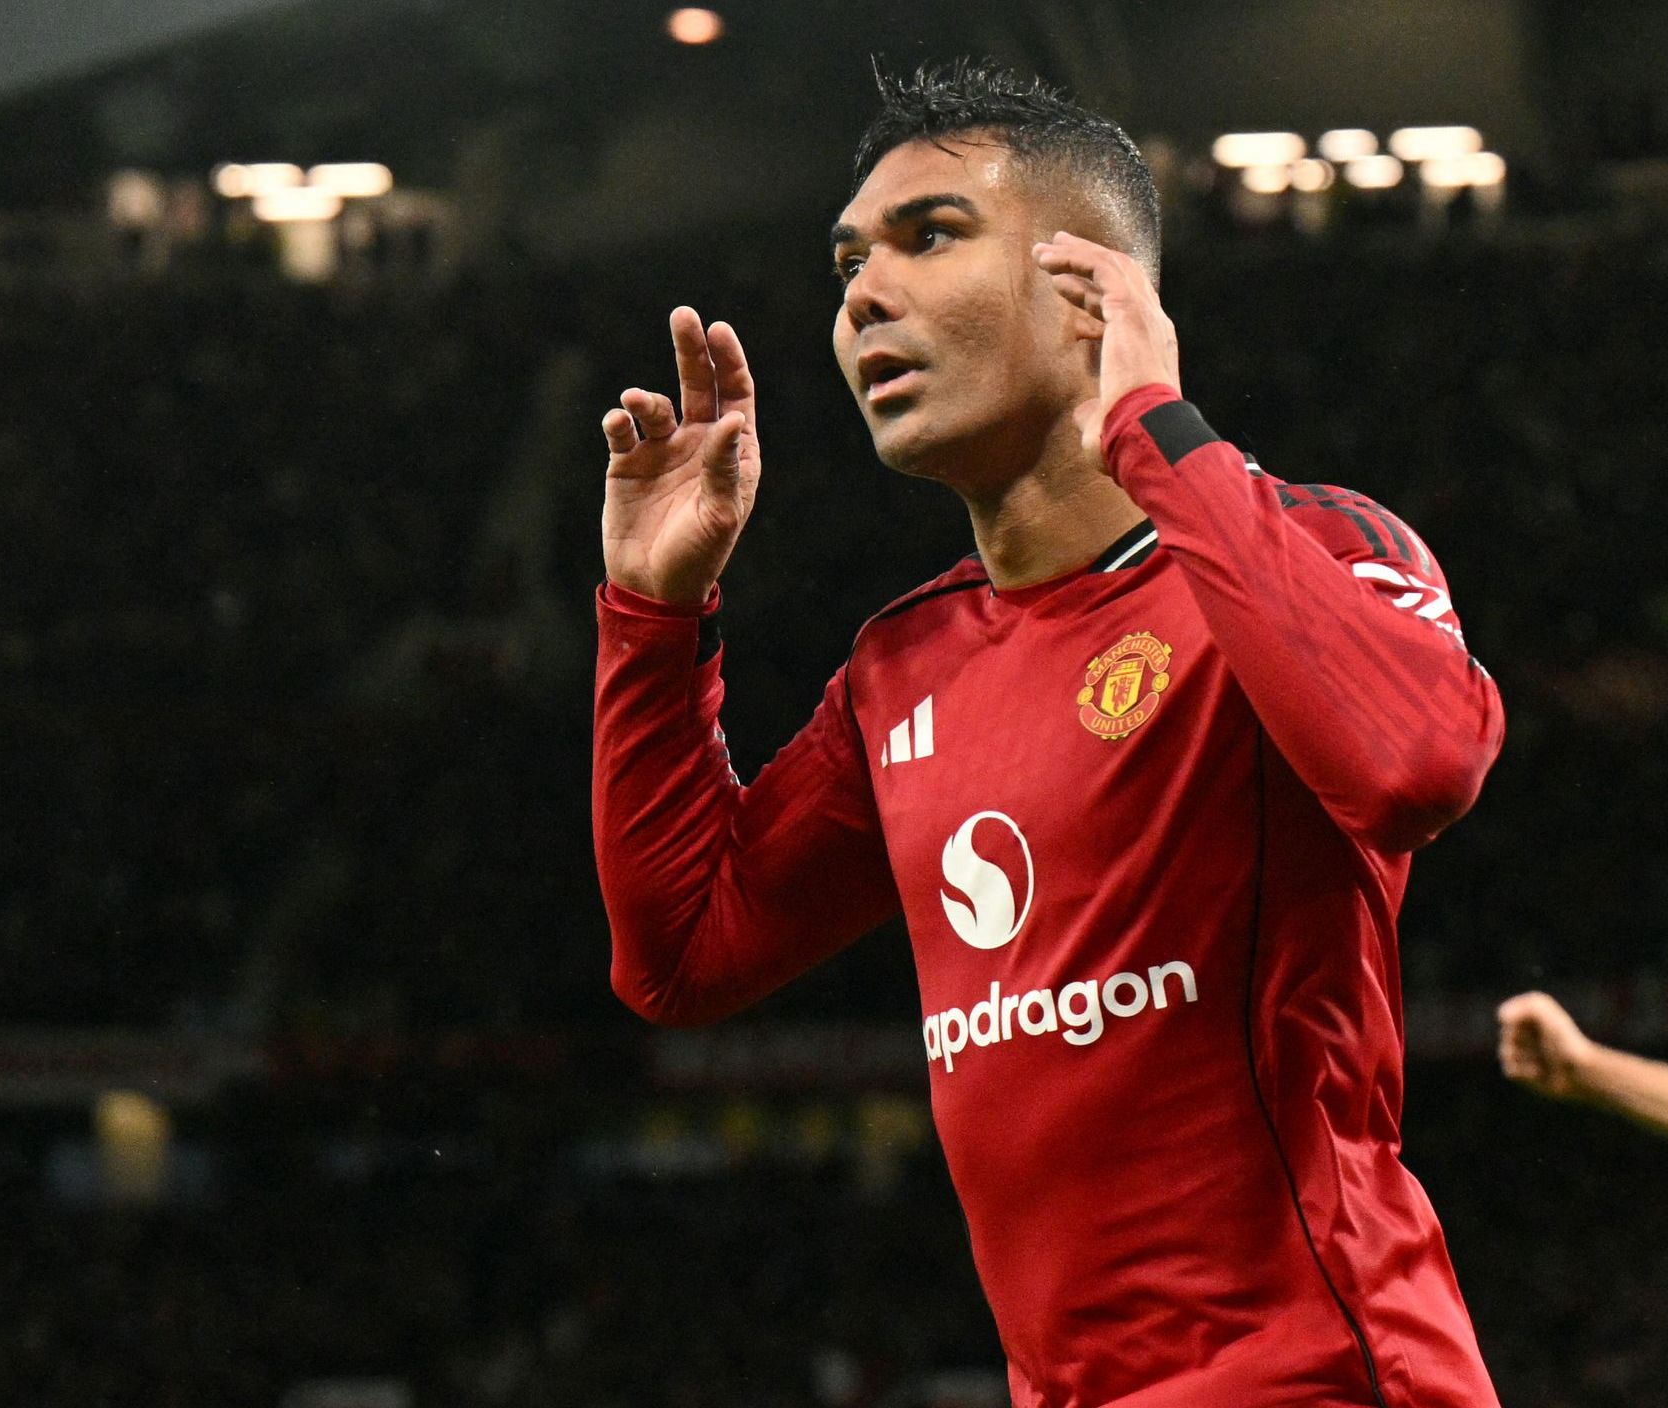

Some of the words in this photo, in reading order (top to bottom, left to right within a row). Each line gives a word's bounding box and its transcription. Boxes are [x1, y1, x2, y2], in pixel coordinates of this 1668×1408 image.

[1092, 638, 1165, 678] MANCHESTER
[1091, 709, 1145, 732] UNITED
[922, 960, 1198, 1074] apdragon
